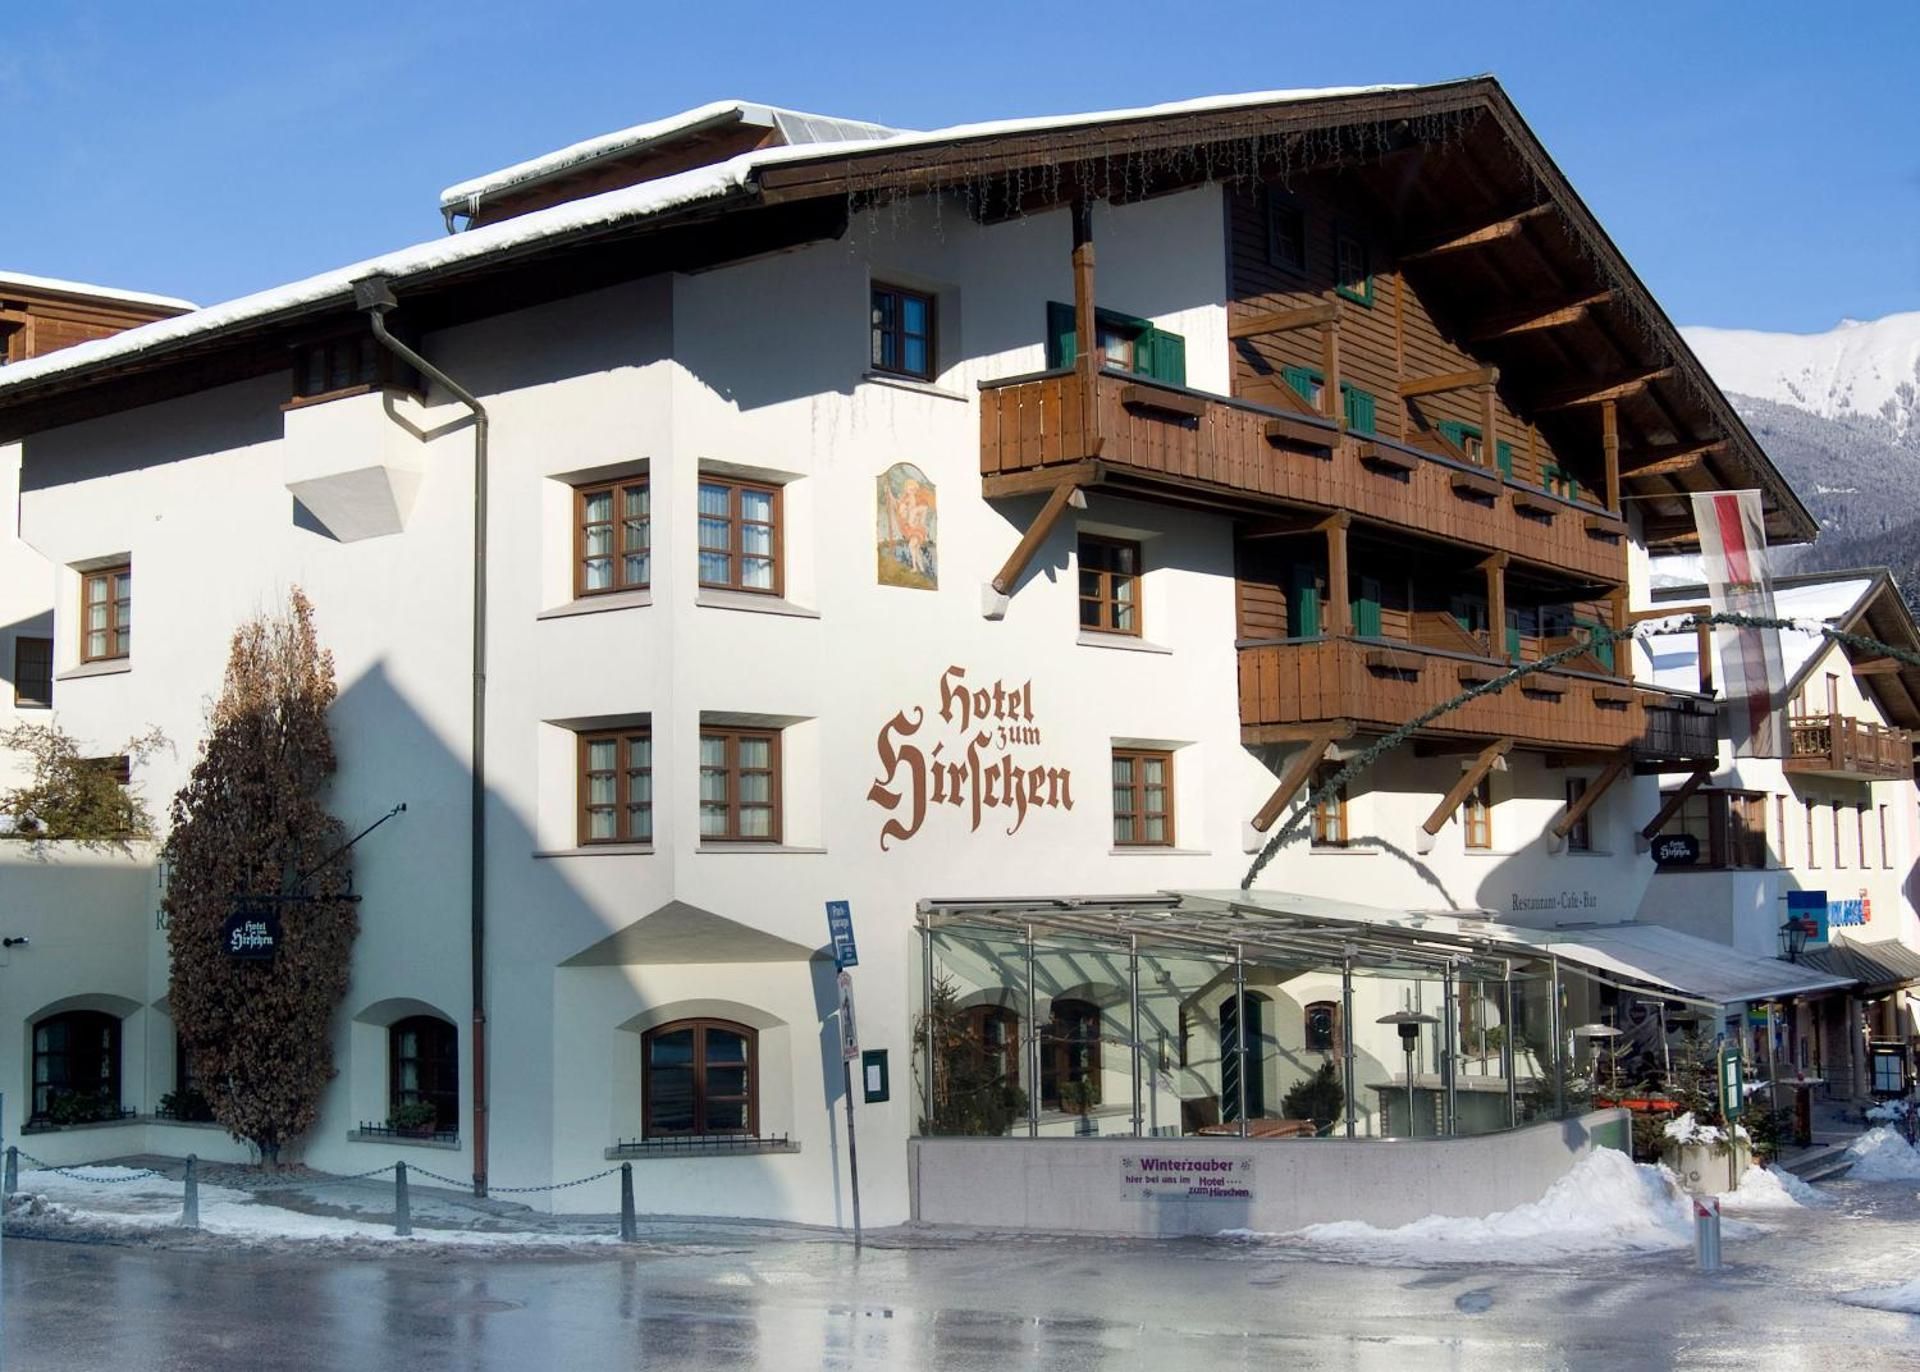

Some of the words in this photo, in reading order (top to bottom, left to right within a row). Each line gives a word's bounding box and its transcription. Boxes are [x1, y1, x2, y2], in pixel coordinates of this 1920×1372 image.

[939, 665, 1035, 734] Hotel
[997, 725, 1041, 750] zum
[1140, 1158, 1234, 1172] Winterzauber
[1199, 1176, 1225, 1186] Hotel
[1189, 1187, 1209, 1195] zum
[1209, 1188, 1250, 1198] Hirschen
